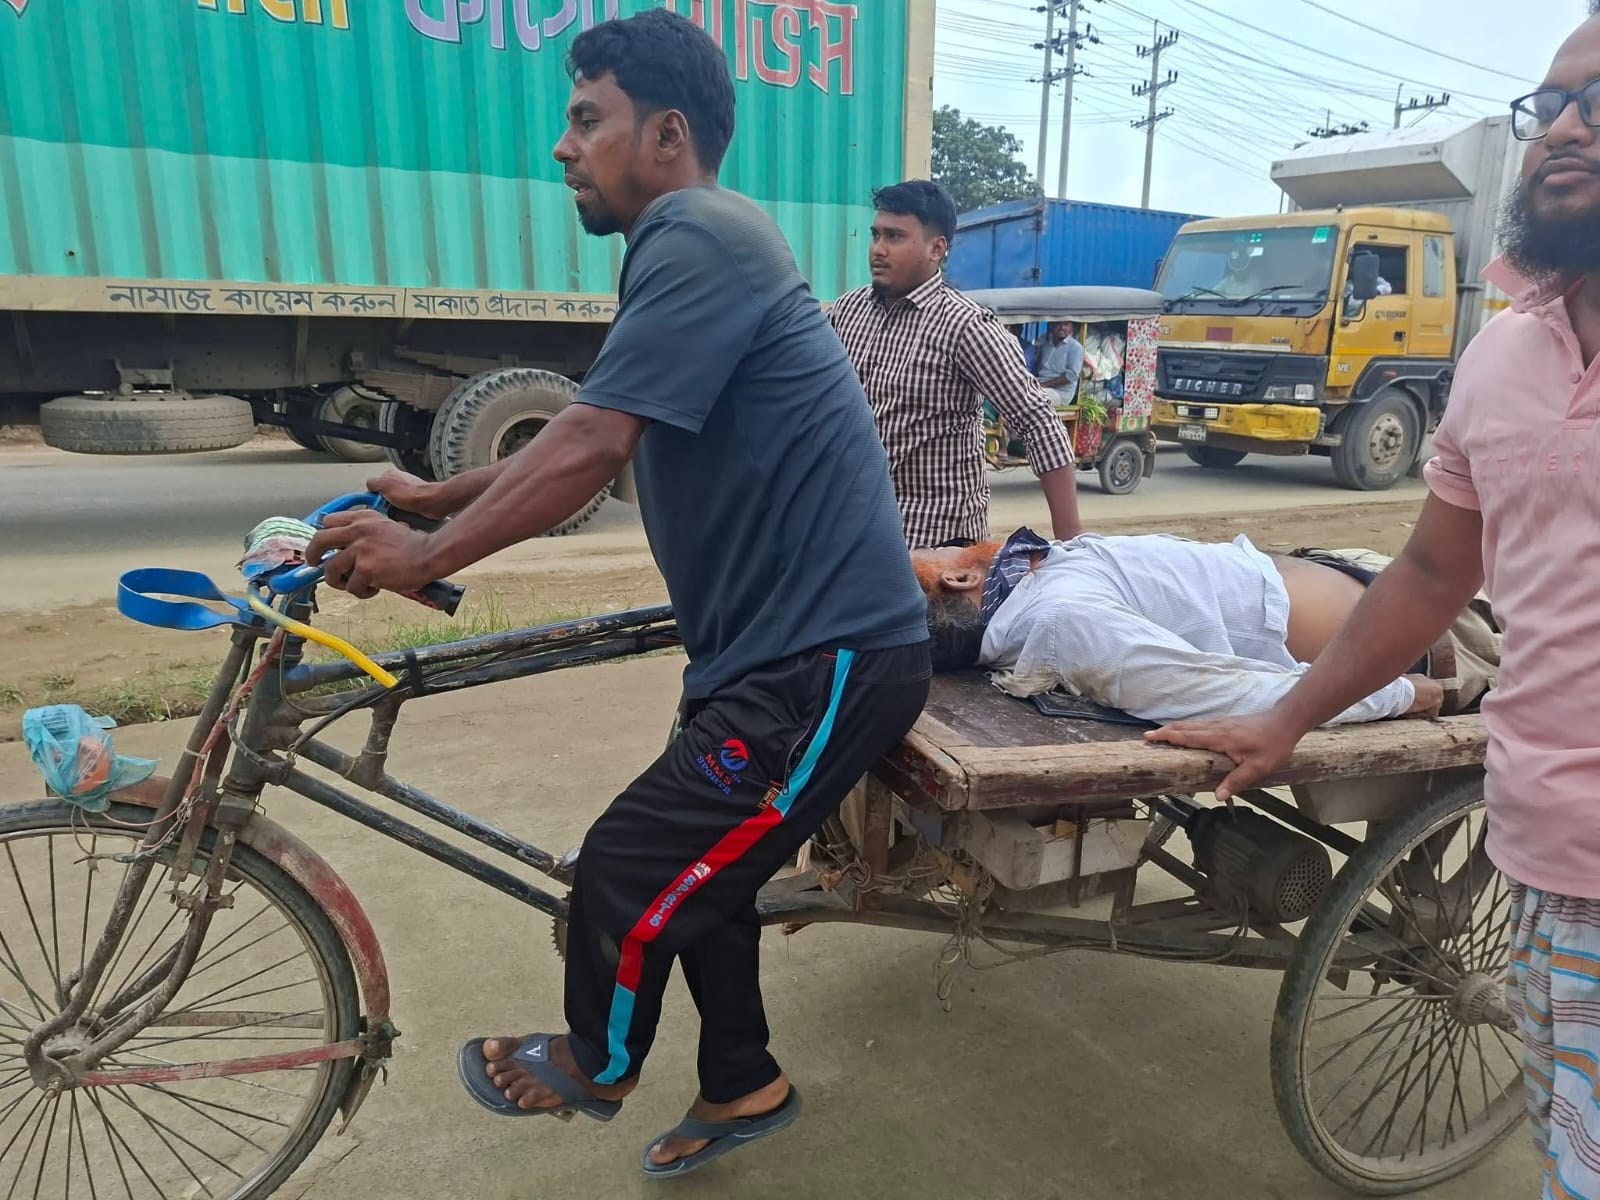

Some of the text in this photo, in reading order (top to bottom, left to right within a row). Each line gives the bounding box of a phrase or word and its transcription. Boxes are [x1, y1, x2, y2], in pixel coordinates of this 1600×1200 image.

[106, 286, 217, 311] নামাজ
[219, 289, 313, 313] কায়েম
[317, 291, 396, 313] করুন
[412, 294, 480, 317] যাকাত
[485, 293, 548, 318] প্রদান
[1174, 379, 1242, 395] EICHER
